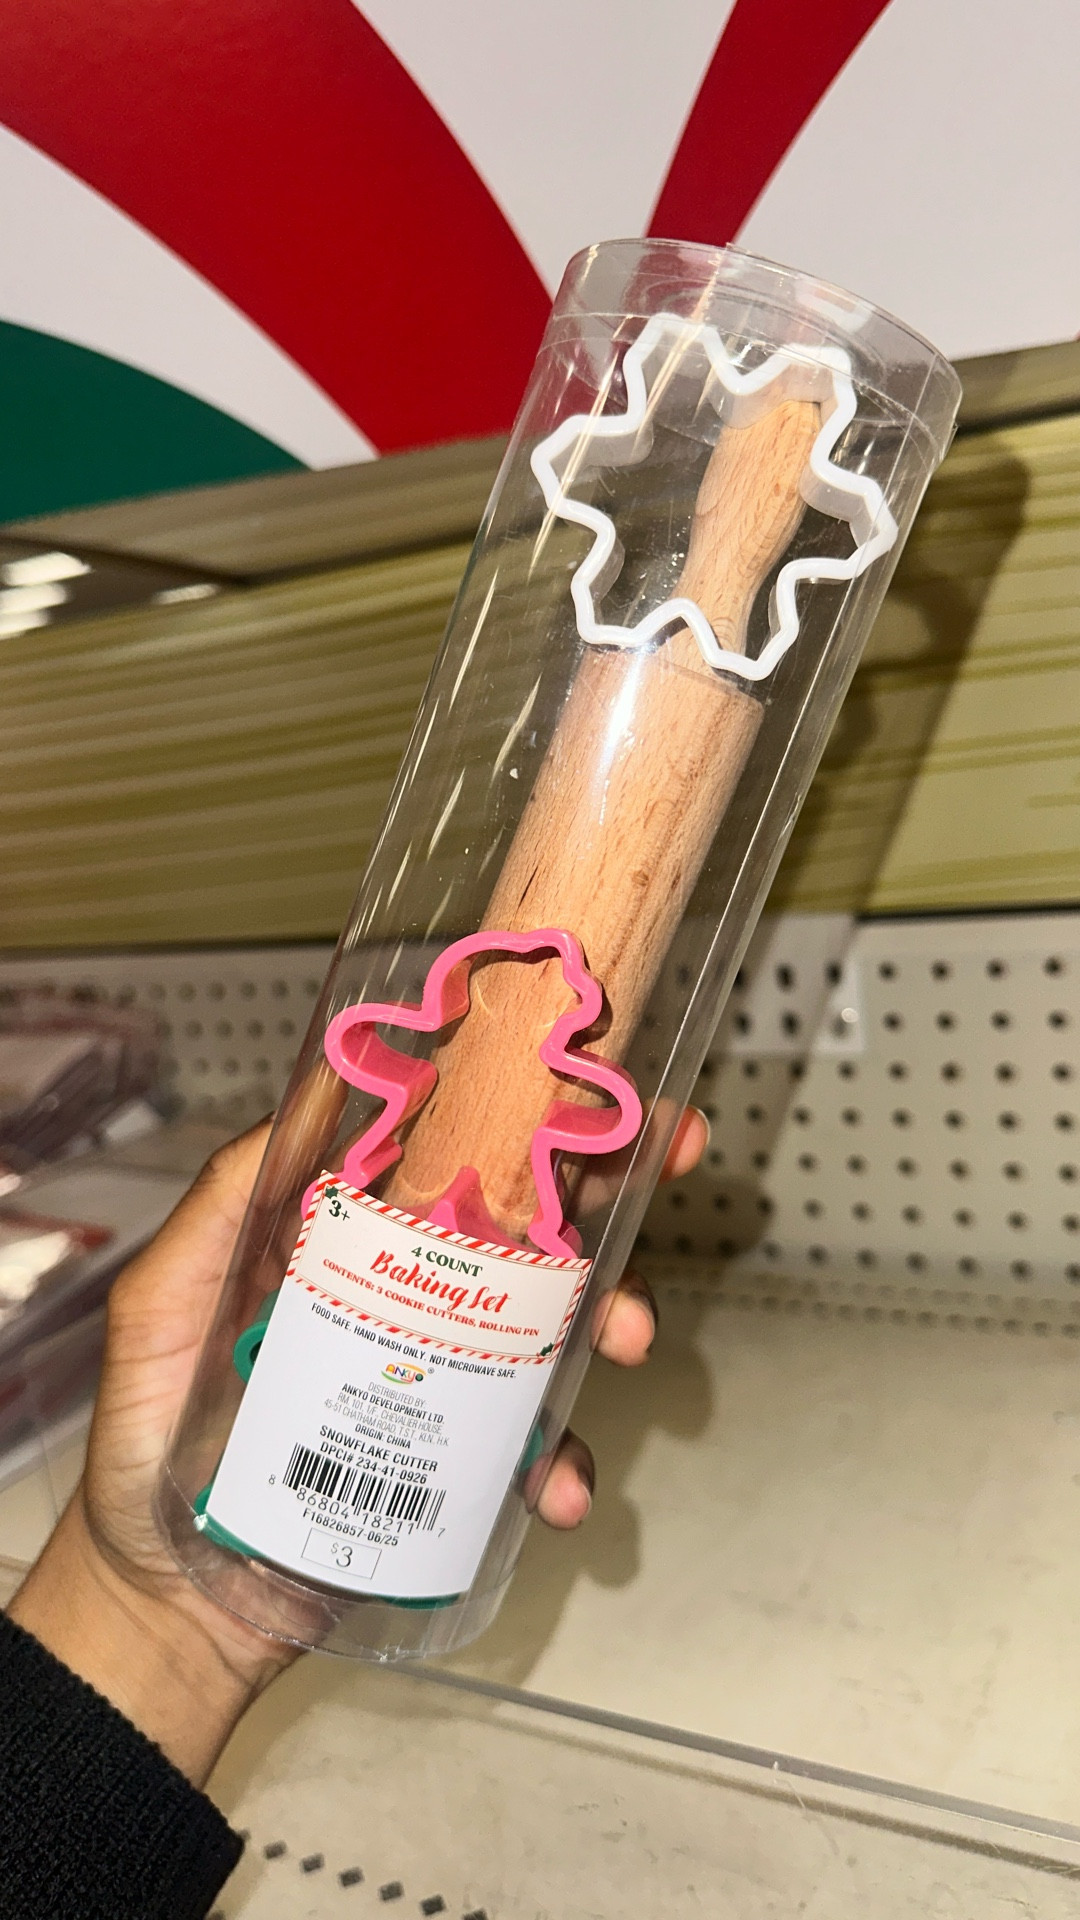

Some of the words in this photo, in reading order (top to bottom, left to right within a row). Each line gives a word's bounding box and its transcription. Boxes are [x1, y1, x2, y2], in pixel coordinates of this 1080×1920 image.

[329, 1200, 350, 1221] 3+
[370, 1250, 469, 1311] Baking
[468, 1286, 512, 1313] Set
[411, 1246, 422, 1257] 4
[426, 1250, 483, 1277] COUNT
[323, 1259, 375, 1290] CONTENTS:
[376, 1285, 383, 1294] 3
[385, 1289, 425, 1311] COOKIE
[427, 1305, 476, 1327] CUTTERS,
[479, 1320, 522, 1335] ROLLING
[523, 1328, 540, 1336] PIN
[311, 1302, 331, 1320] FOOD
[332, 1314, 351, 1331] SAFE.
[354, 1325, 376, 1341] HAND
[377, 1337, 402, 1351] WASH
[403, 1346, 427, 1361] ONLY.
[429, 1353, 447, 1366] NOT
[447, 1358, 496, 1376] MICROWAVE
[497, 1368, 517, 1378] SAFE.
[324, 1398, 341, 1413] 45-51
[342, 1407, 377, 1426] CHATHAM
[342, 1383, 369, 1400] ANKYO
[369, 1394, 427, 1420] DEVELOPMENT
[428, 1412, 444, 1424] LTD.
[368, 1382, 414, 1404] DISTRIBUTED
[414, 1397, 426, 1408] BY:
[355, 1423, 385, 1441] ORIGIN:
[386, 1434, 411, 1449] CHINA
[381, 1409, 418, 1429] CHEVALIER
[418, 1422, 442, 1434] HOUSE,
[320, 1425, 392, 1460] SNOWFLAKE
[392, 1453, 438, 1472] CUTTER
[320, 1441, 354, 1463] DPCI#
[355, 1456, 428, 1485] 234-41-0926
[268, 1474, 276, 1485] 8
[296, 1487, 350, 1520] 86804
[362, 1512, 415, 1535] 18211
[437, 1527, 446, 1538] 7
[302, 1507, 399, 1546] F16826857-06/25
